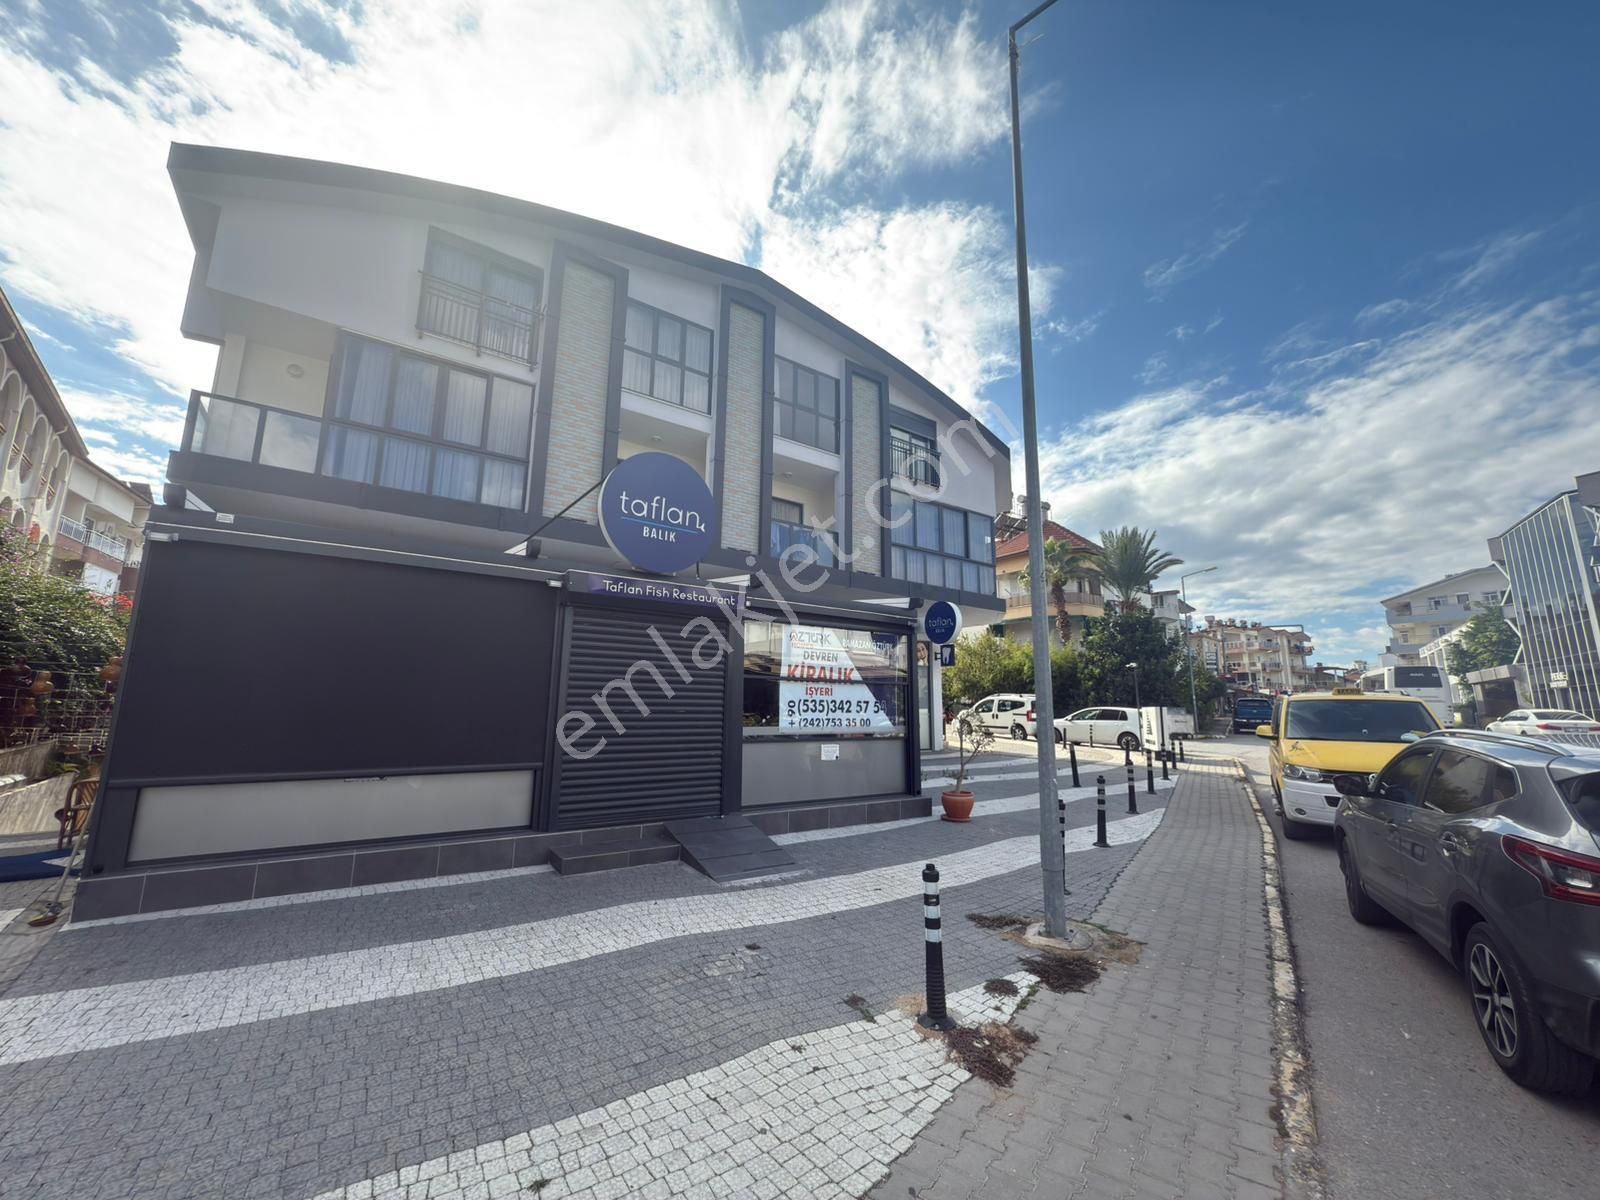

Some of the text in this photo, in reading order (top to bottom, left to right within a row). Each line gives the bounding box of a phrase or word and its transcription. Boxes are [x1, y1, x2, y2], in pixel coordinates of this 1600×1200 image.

[620, 490, 705, 533] taflan
[643, 526, 677, 543] BALIK
[603, 579, 736, 606] Taflan Fish Restaurant
[803, 650, 839, 663] DEVREN
[786, 661, 855, 684] KİRALIK
[805, 684, 833, 698] İŞYERİ
[797, 698, 852, 717] (535)342
[856, 701, 870, 714] 57
[798, 717, 871, 729] (242)753 35 00
